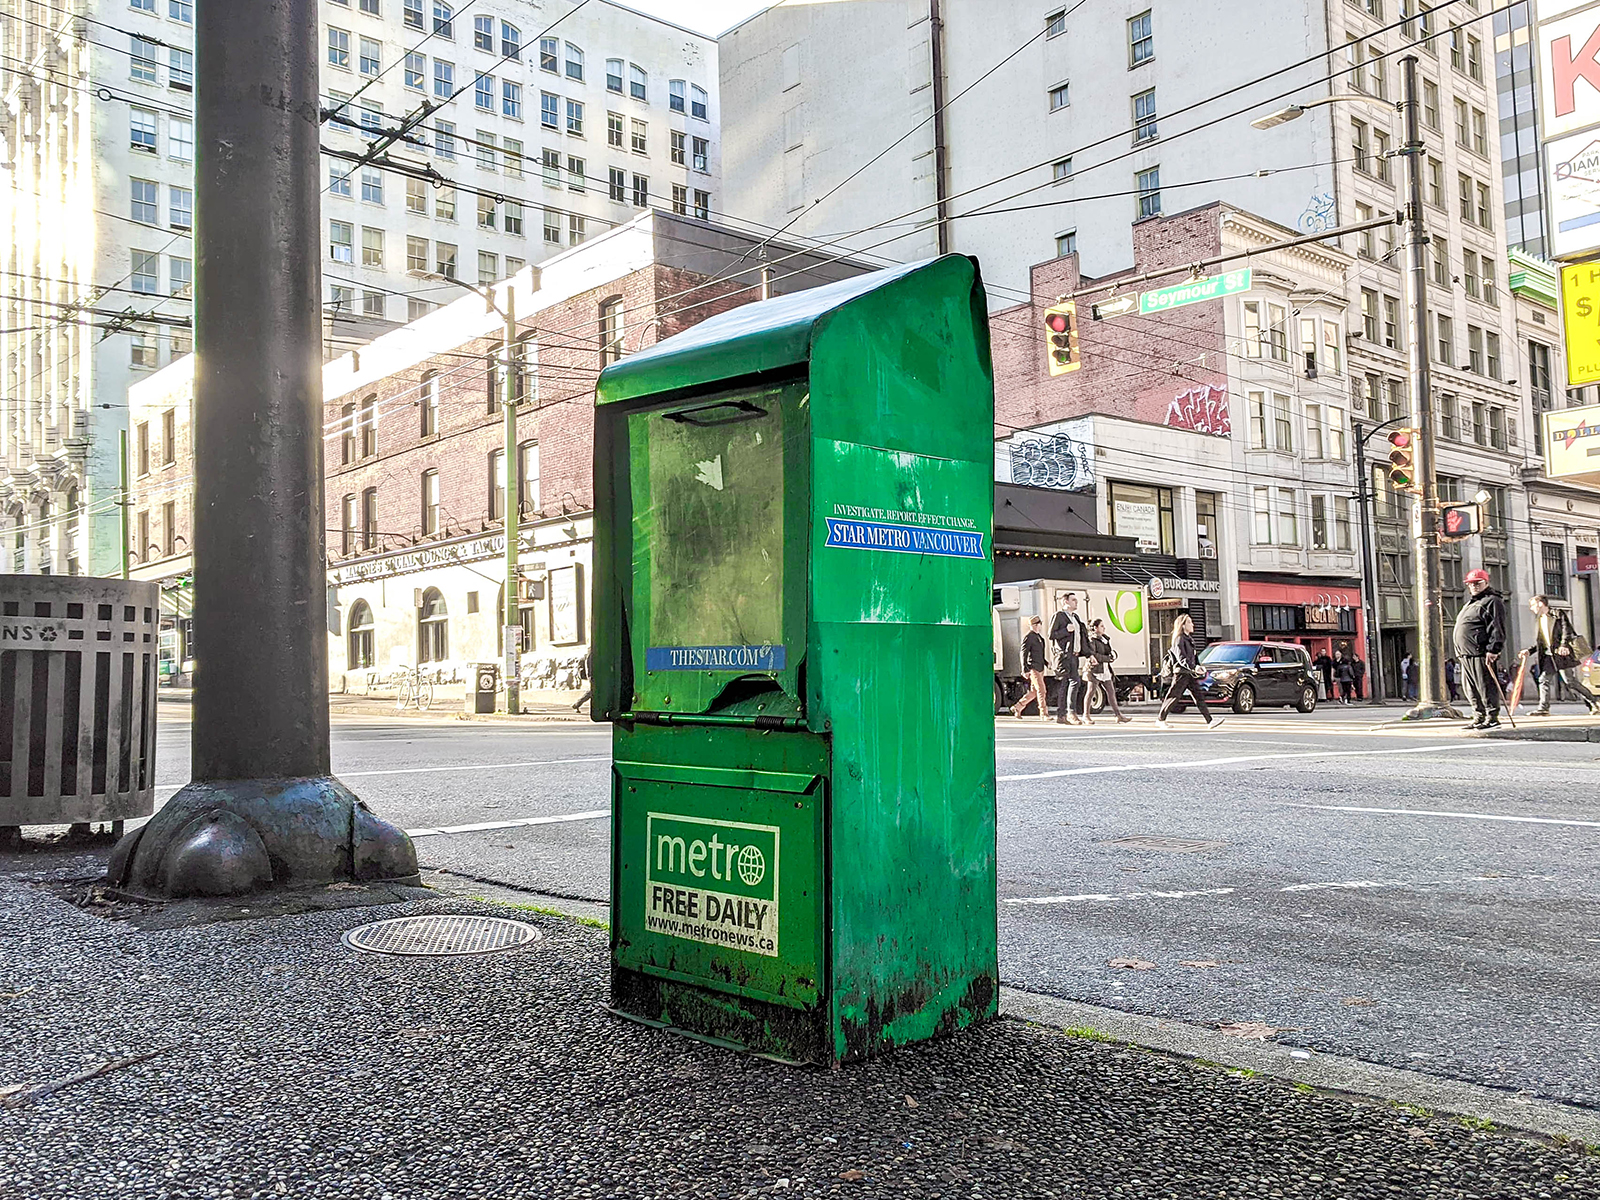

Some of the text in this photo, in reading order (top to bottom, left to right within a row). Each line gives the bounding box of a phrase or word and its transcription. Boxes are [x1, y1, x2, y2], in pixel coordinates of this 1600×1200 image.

[1147, 272, 1244, 308] Seymour St
[1570, 273, 1579, 287] 1
[833, 503, 977, 529] INVESTIGATE. REPORT. EFFECT CHANGE.
[833, 523, 979, 553] STAR METRO VANCOUVER
[385, 554, 416, 572] SOCIAL
[1163, 578, 1220, 592] BURGER KING
[2, 625, 33, 641] NS
[670, 648, 759, 666] THESTAR.COM
[657, 833, 765, 886] metro
[652, 885, 768, 931] FREE DAILY
[647, 914, 774, 951] www.metronews.ca
